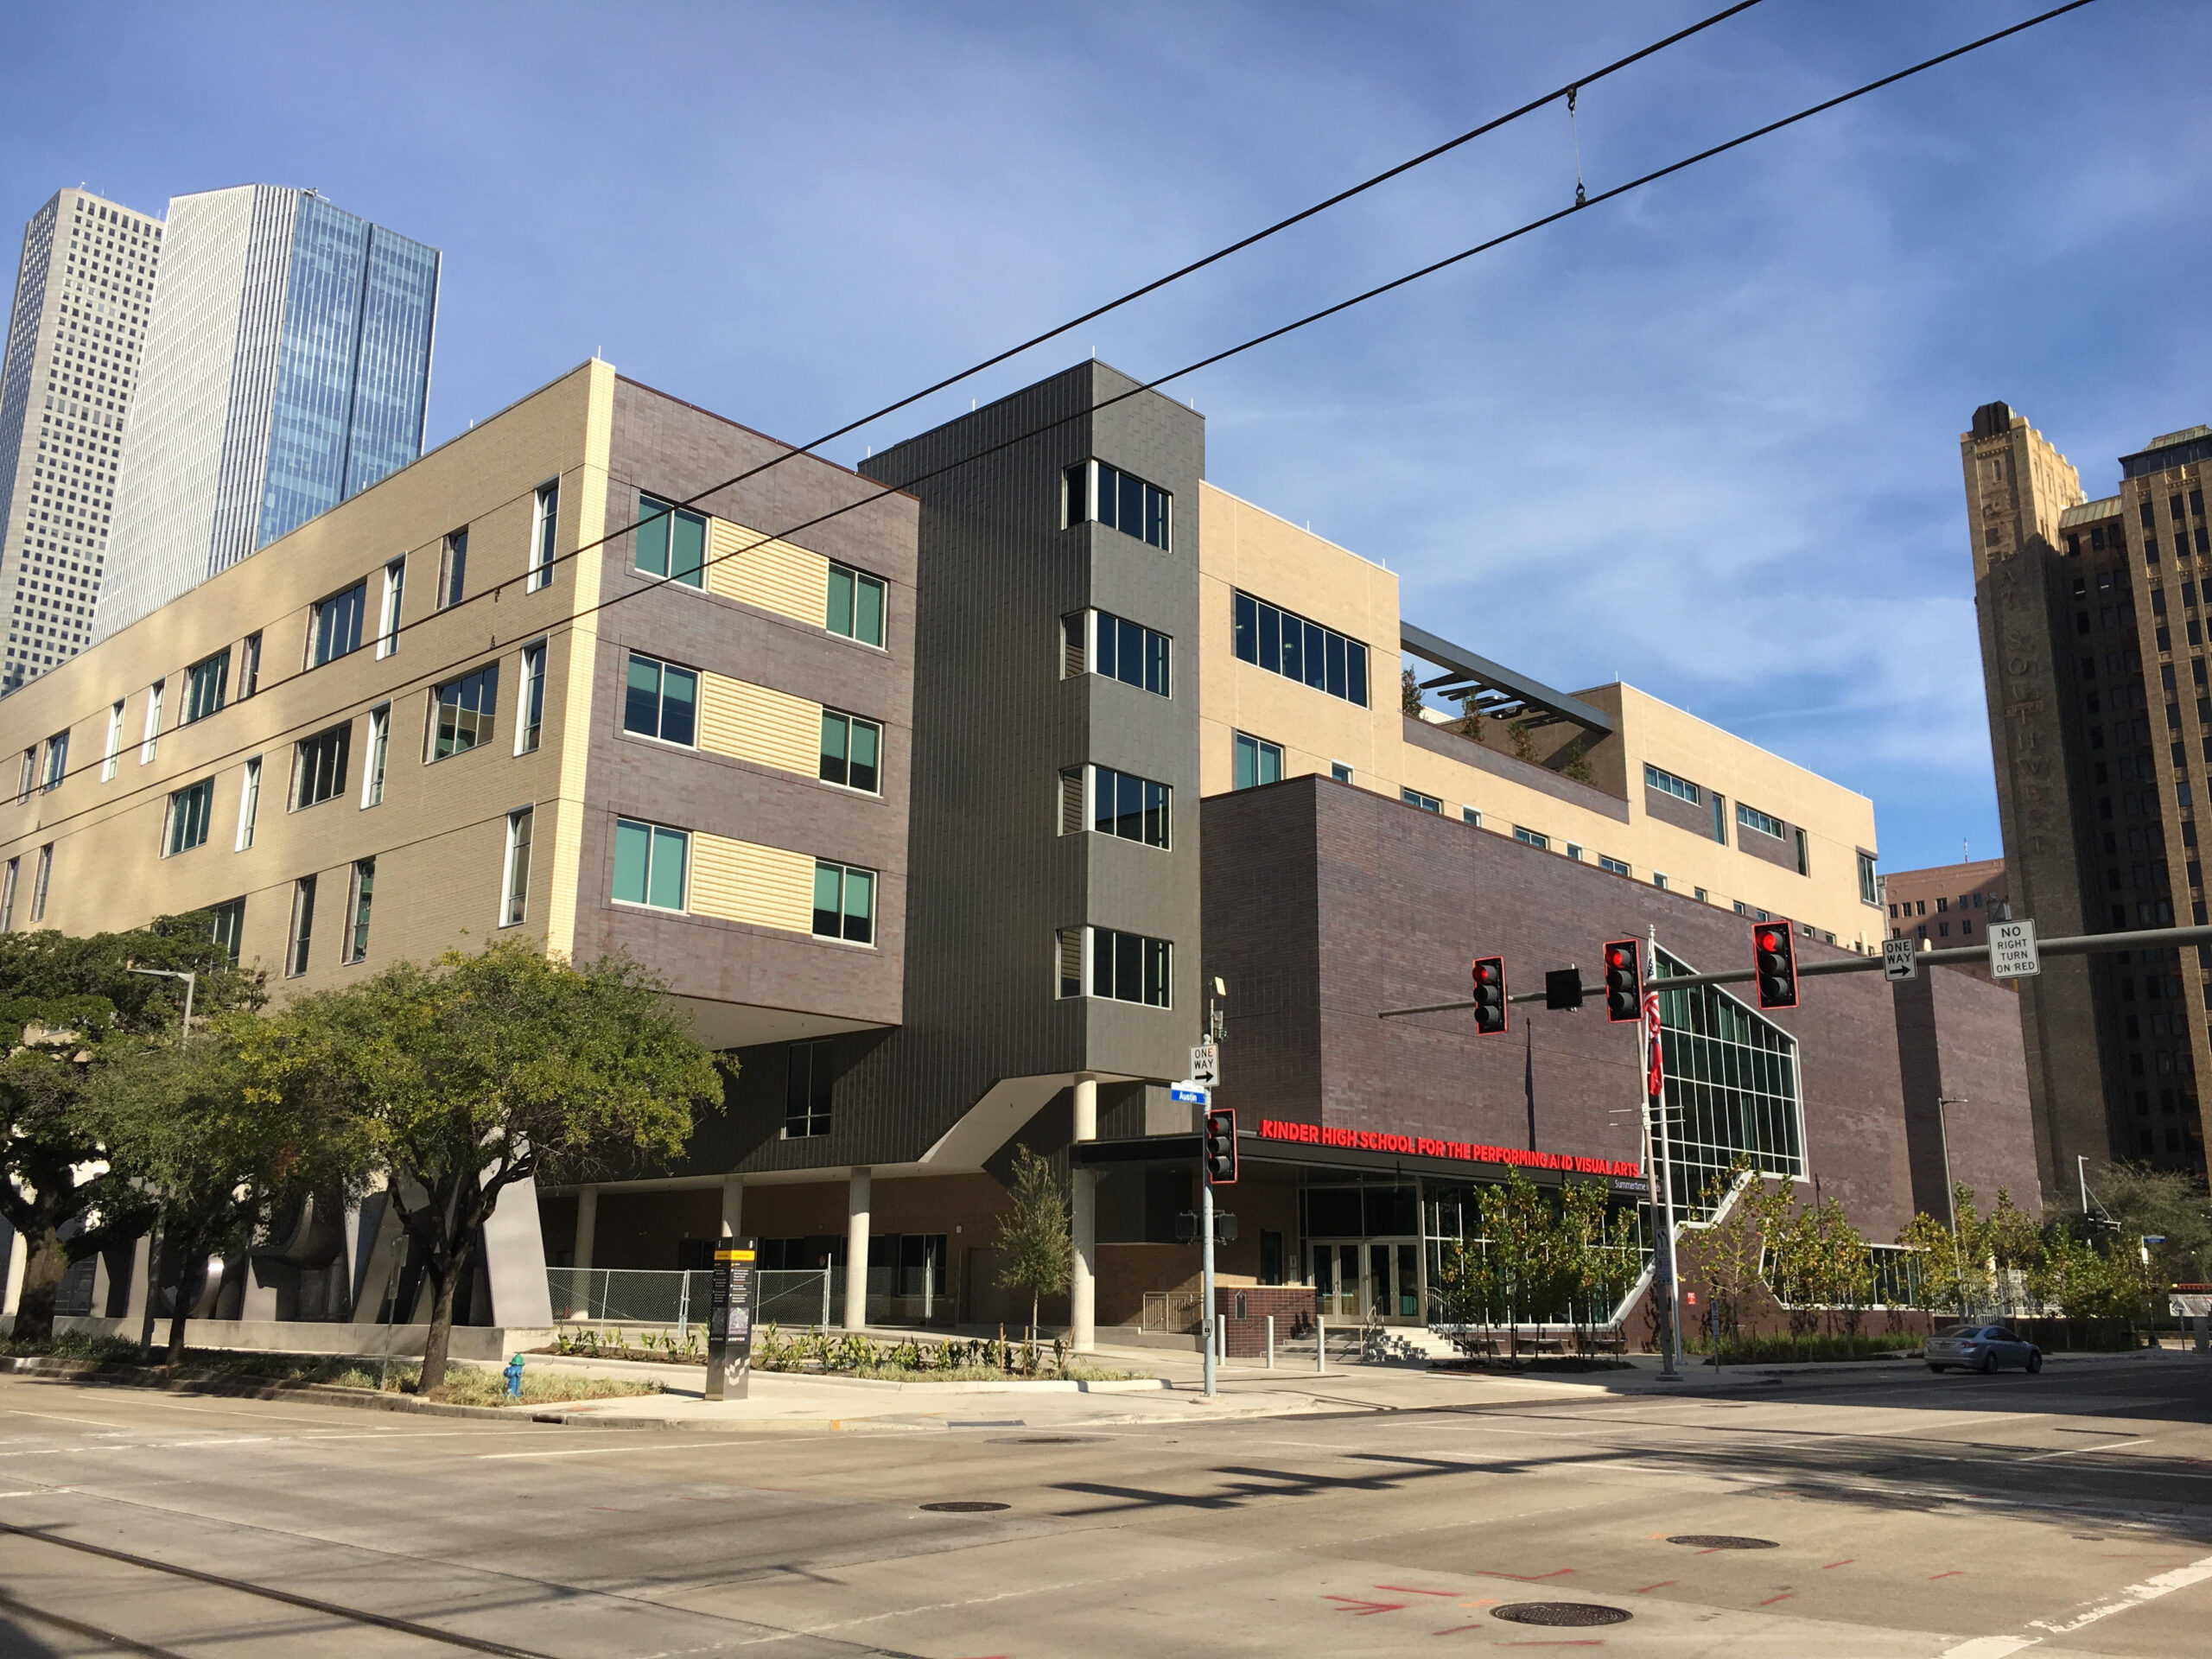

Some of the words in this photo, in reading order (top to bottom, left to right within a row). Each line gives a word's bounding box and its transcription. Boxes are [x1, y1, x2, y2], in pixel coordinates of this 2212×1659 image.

[2001, 926, 2021, 938] NO
[1886, 941, 1910, 953] ONE
[1998, 939, 2028, 950] RIGHT
[1887, 953, 1911, 964] WAY
[2000, 950, 2028, 961] TURN
[1996, 963, 2012, 974] ON
[2014, 961, 2035, 972] RED
[1195, 1048, 1213, 1058] ONE
[1194, 1058, 1213, 1069] WAY
[1179, 1091, 1197, 1103] Austin
[1261, 1119, 1319, 1142] KINDER
[1321, 1127, 1357, 1147] HIGH
[1358, 1131, 1415, 1154] SCHOOL
[1418, 1137, 1445, 1156] FOR
[1447, 1142, 1471, 1160] THE
[1473, 1145, 1548, 1168] PERFORMING
[1549, 1154, 1573, 1170] AND
[1576, 1157, 1612, 1175] VISUAL
[1613, 1160, 1639, 1177] ARTS
[1614, 1179, 1646, 1191] Summertime
